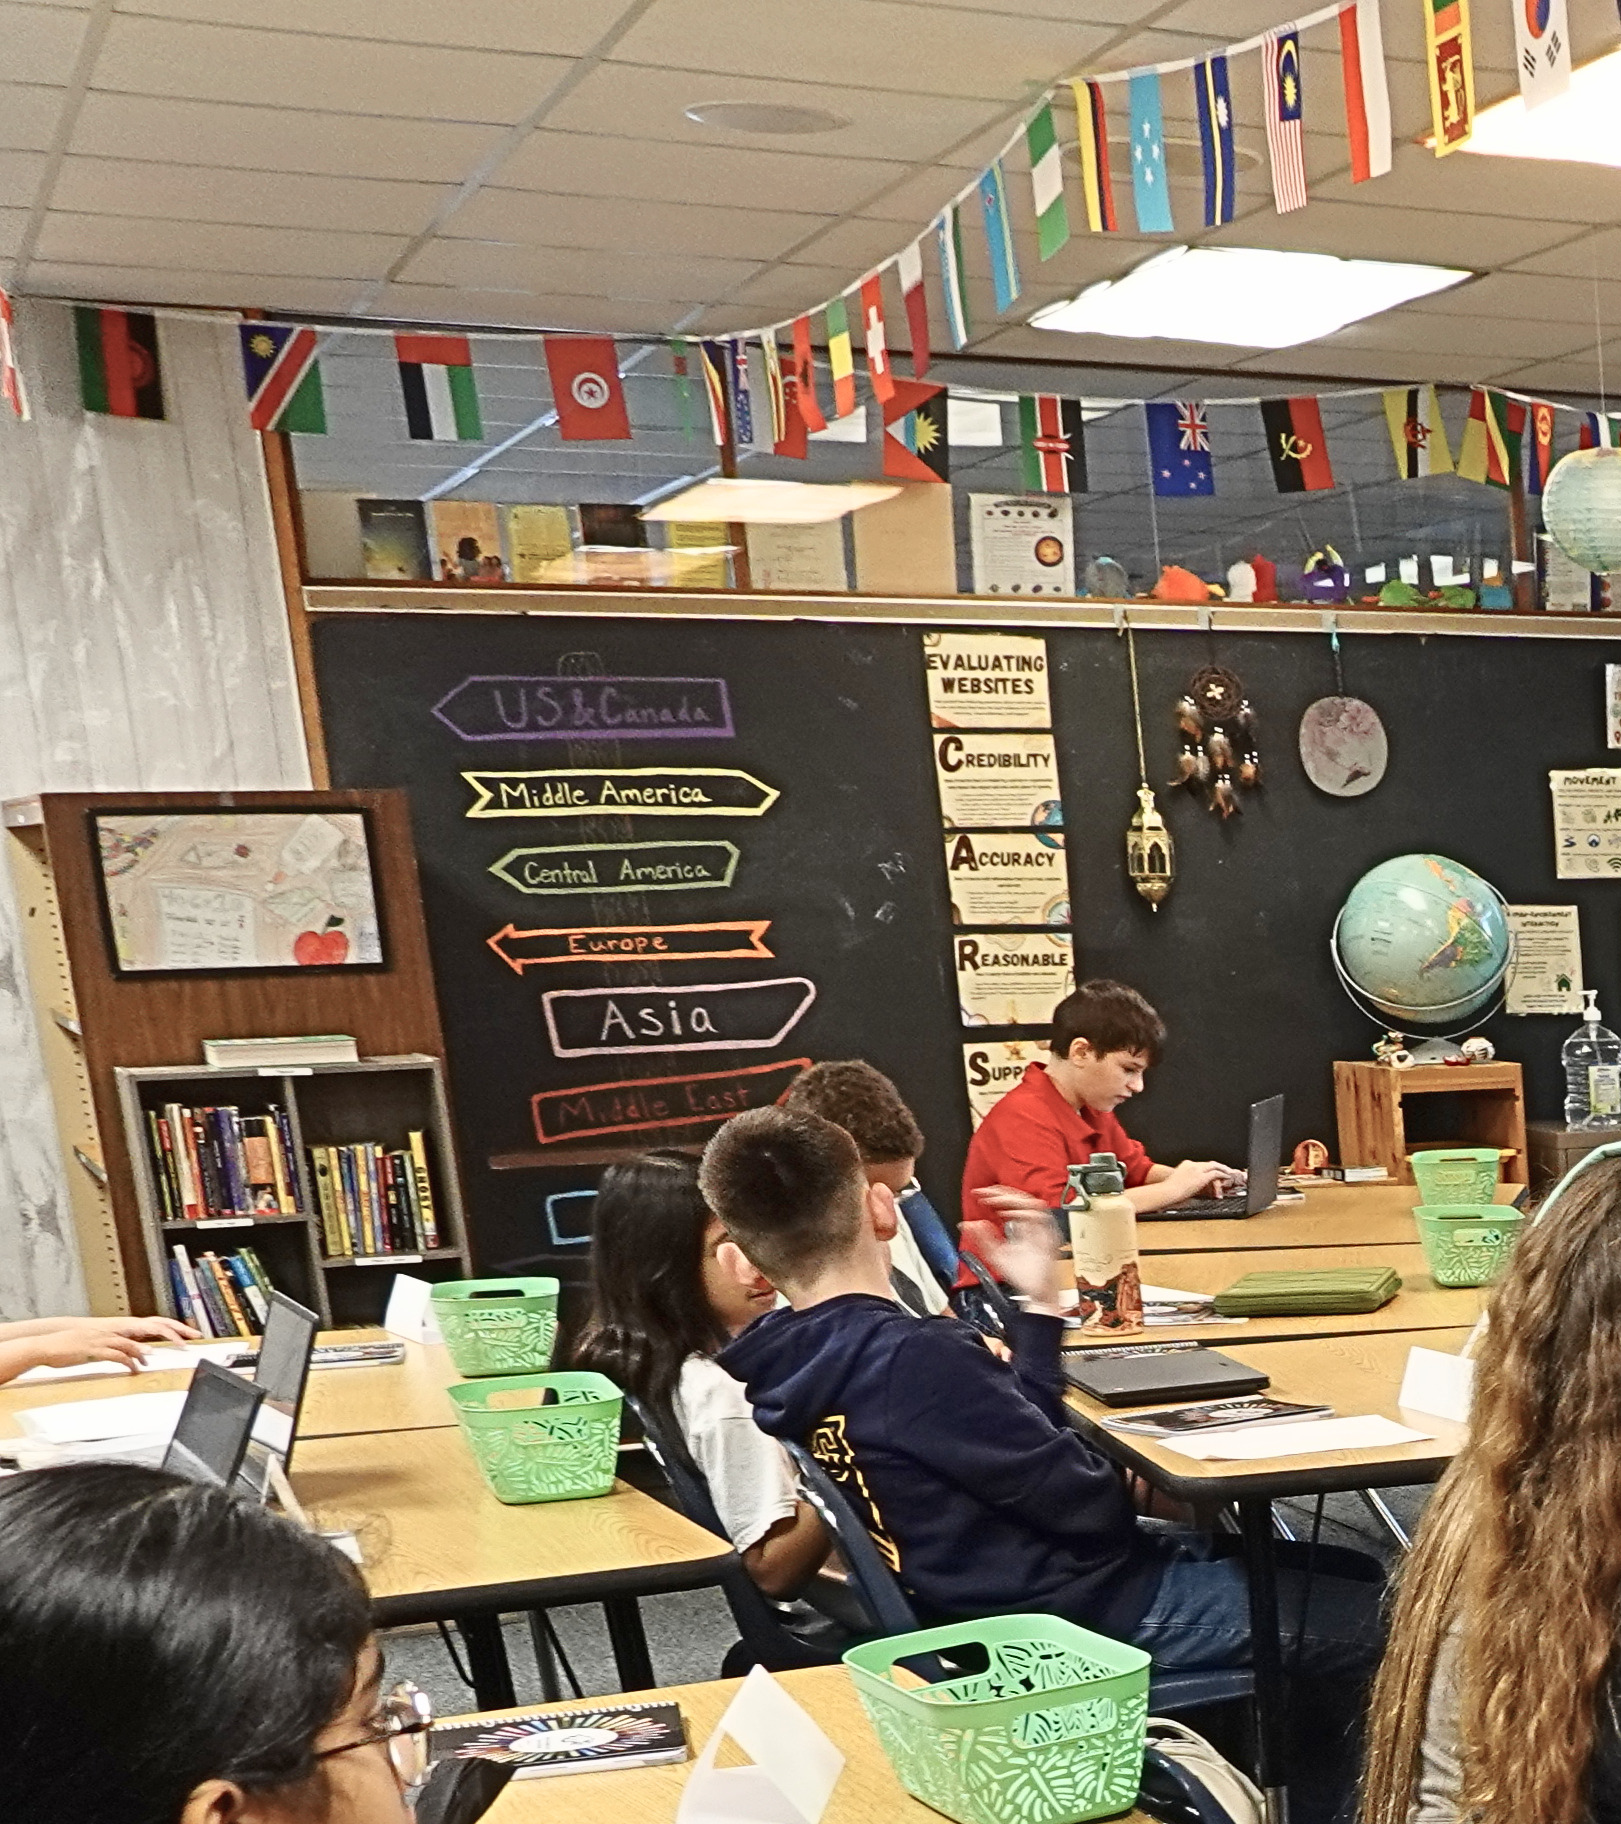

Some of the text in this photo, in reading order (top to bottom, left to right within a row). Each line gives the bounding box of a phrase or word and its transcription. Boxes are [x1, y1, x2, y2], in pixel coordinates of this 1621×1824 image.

[926, 653, 1045, 673] EVALUATING
[940, 677, 1034, 695] WEBSITES
[499, 780, 714, 809] Middle America
[1563, 776, 1618, 787] MOVEMENT
[523, 858, 713, 885] Central America
[567, 934, 669, 954] Europe
[600, 1000, 720, 1041] Asia
[968, 1051, 1027, 1086] SUPP
[560, 1084, 752, 1124] Middle East
